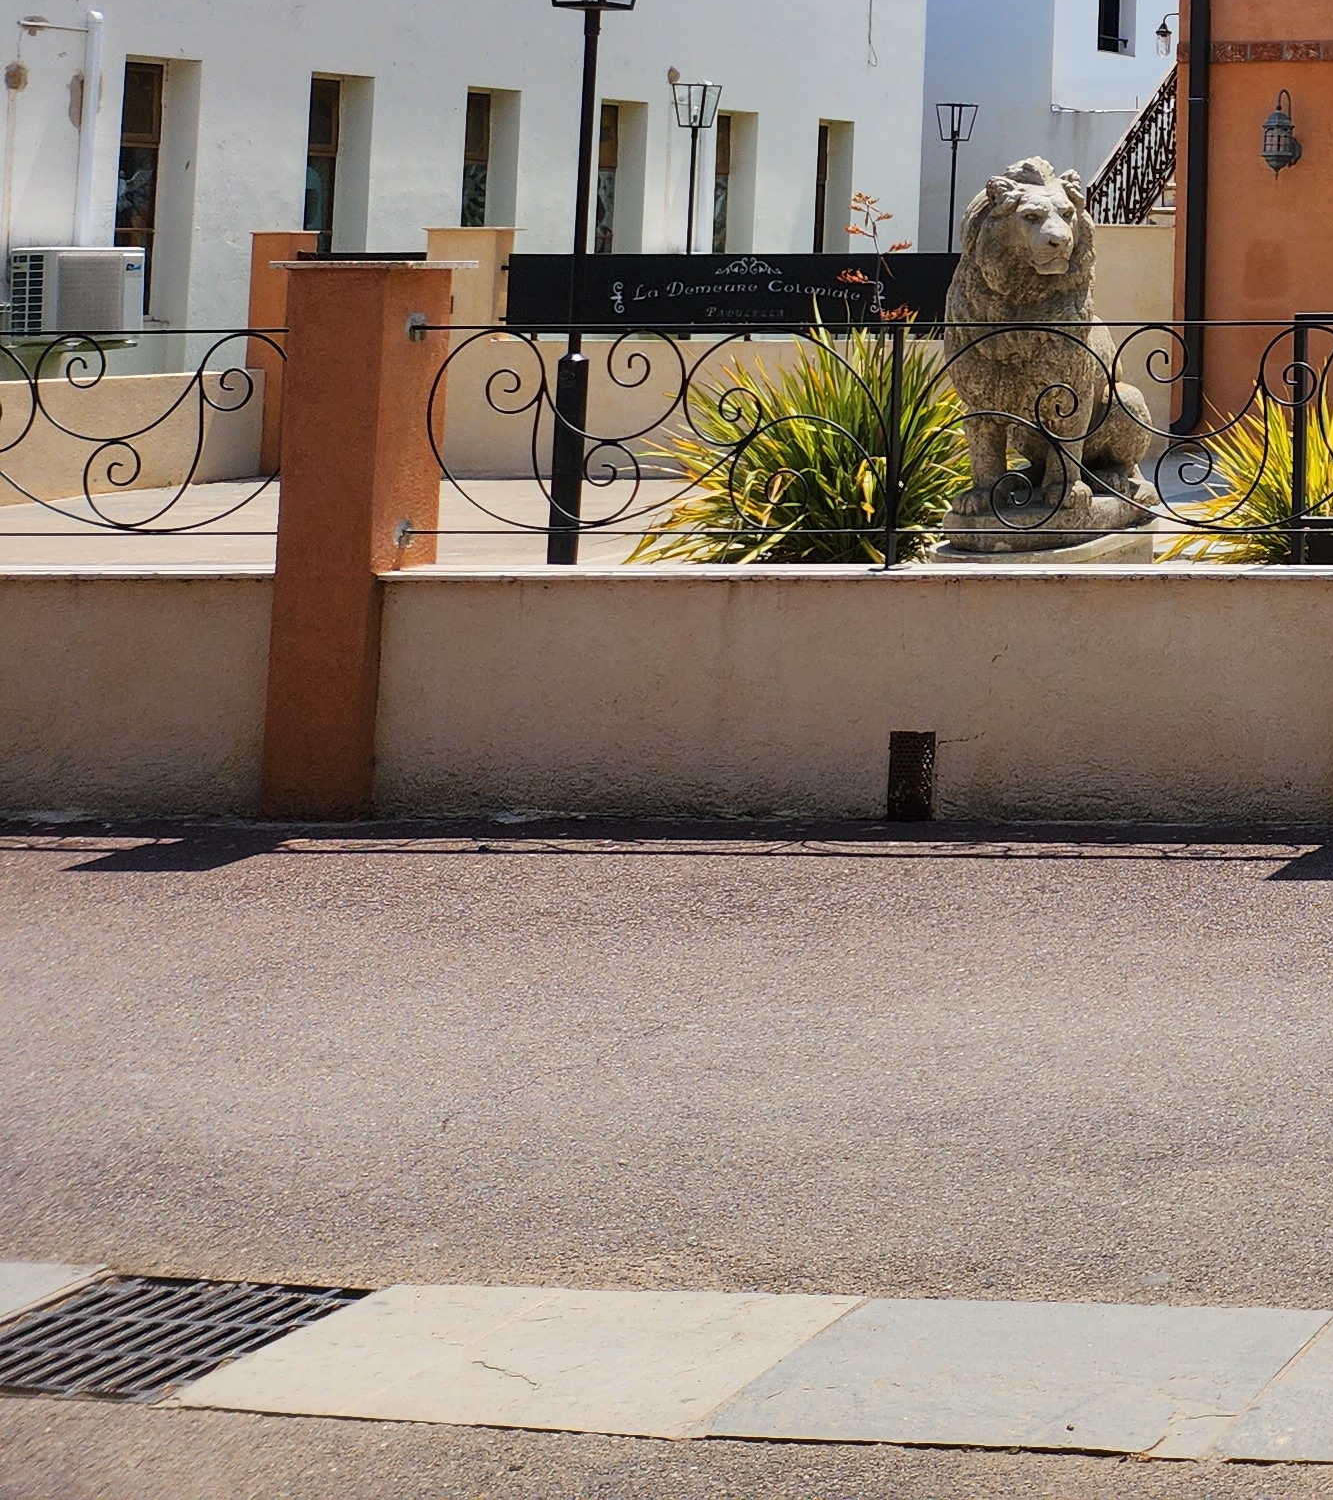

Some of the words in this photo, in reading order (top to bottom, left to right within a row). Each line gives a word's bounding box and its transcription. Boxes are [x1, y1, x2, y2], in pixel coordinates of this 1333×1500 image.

[632, 284, 659, 301] La
[666, 281, 758, 298] Demeure
[767, 279, 861, 301] Coloniale
